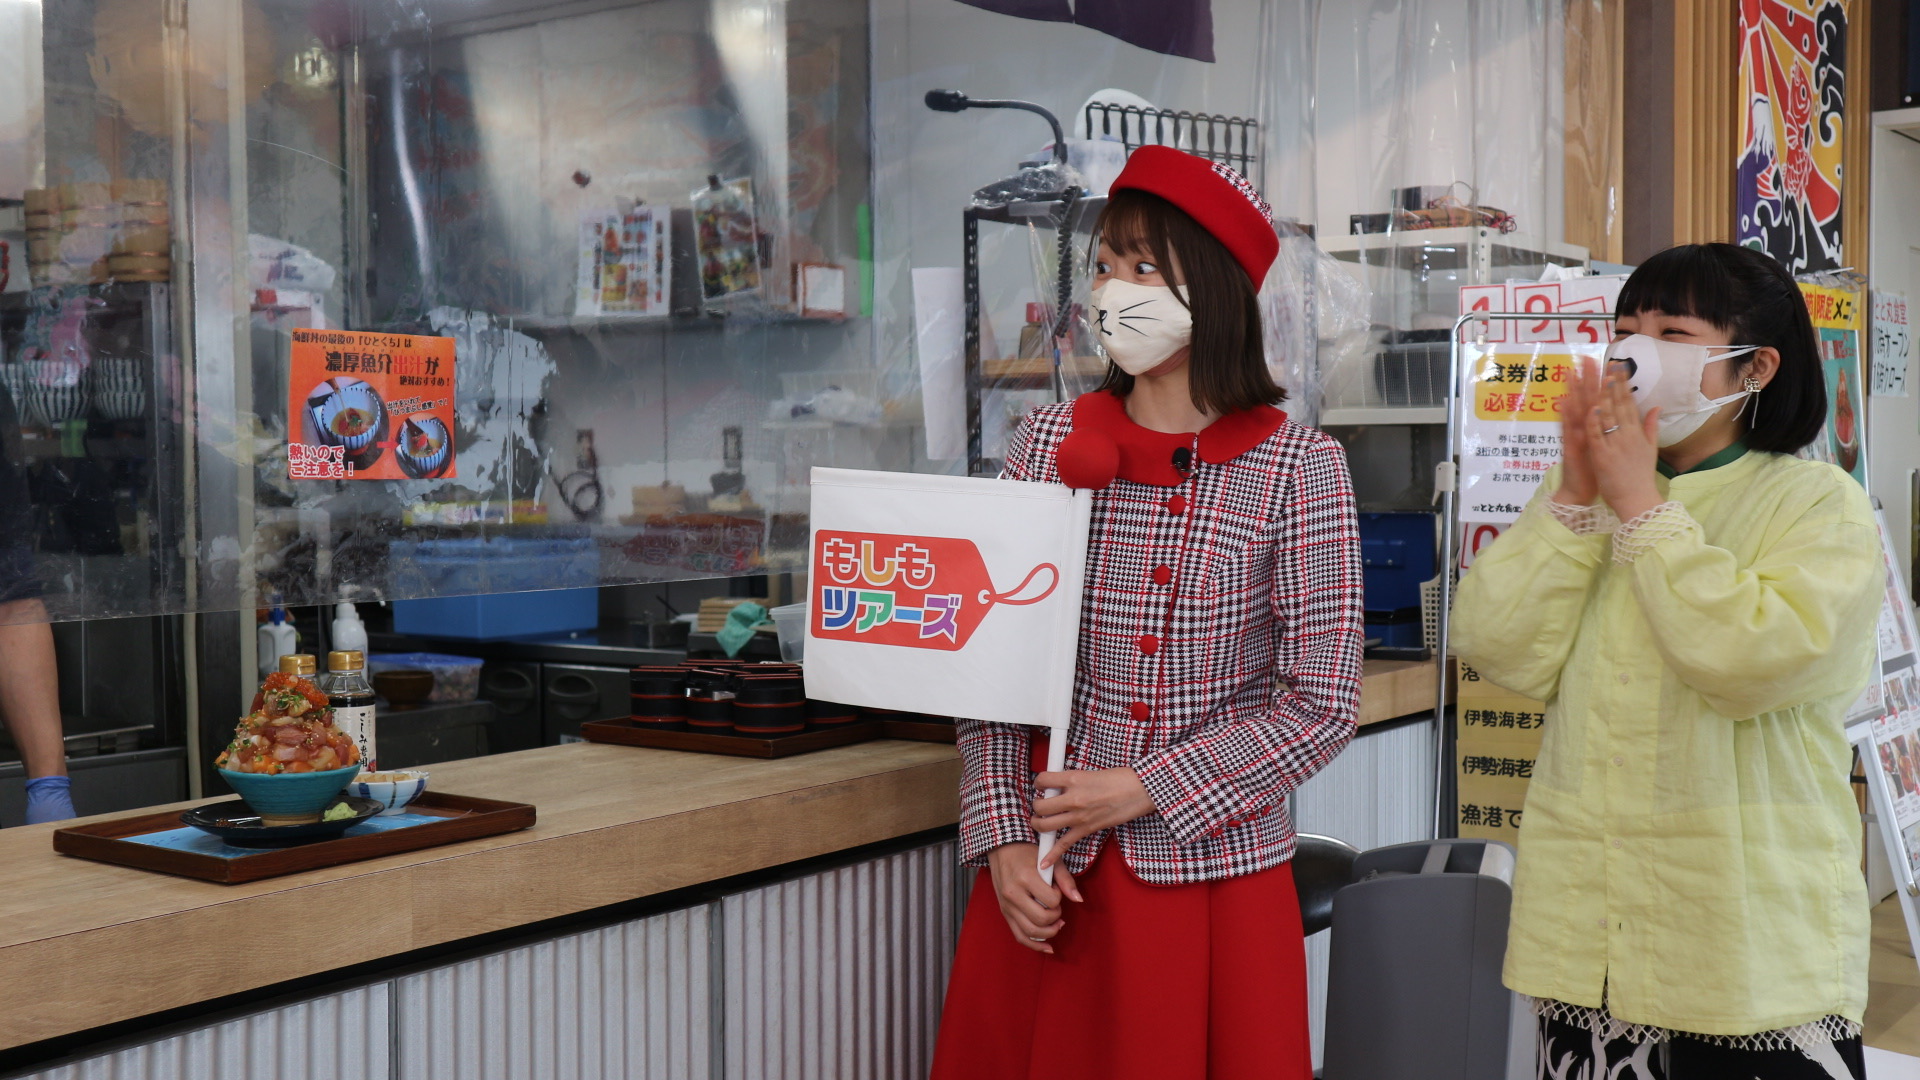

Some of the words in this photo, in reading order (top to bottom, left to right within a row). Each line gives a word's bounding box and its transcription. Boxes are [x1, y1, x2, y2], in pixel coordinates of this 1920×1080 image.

[1525, 294, 1552, 333] 9
[325, 351, 439, 375] 濃厚魚介出汁が
[288, 443, 345, 461] 熱いので
[291, 461, 354, 478] ご注意を！
[1503, 460, 1558, 470] 食券は持っ
[823, 538, 935, 590] もしも
[822, 585, 962, 644] ツアーズ
[1462, 755, 1536, 778] 伊勢海老
[1461, 803, 1523, 829] 漁港で
